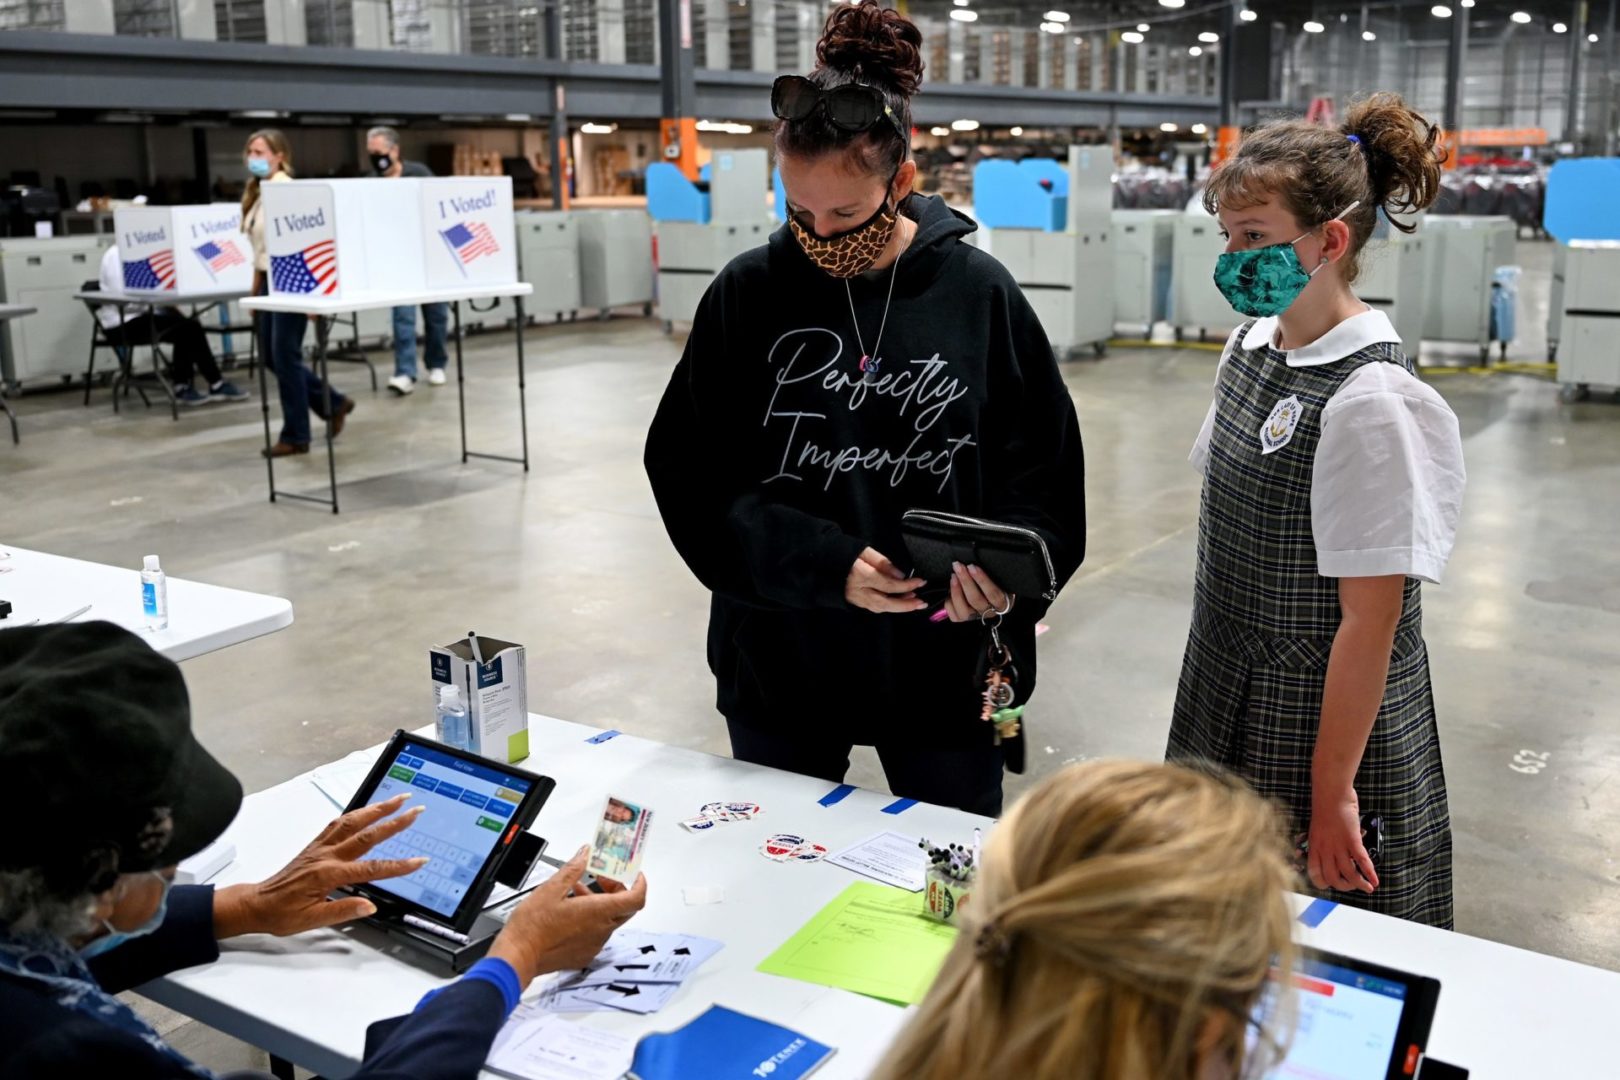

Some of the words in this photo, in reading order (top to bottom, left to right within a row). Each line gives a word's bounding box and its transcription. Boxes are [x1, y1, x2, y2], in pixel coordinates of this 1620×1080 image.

[438, 200, 447, 219] I
[449, 188, 497, 214] Voted!
[124, 231, 132, 248] I
[132, 225, 167, 244] Voted
[190, 223, 198, 239] I
[274, 216, 282, 237] I
[283, 206, 325, 232] Voted
[763, 327, 969, 432] Perfectly
[761, 410, 977, 494] Imperfect
